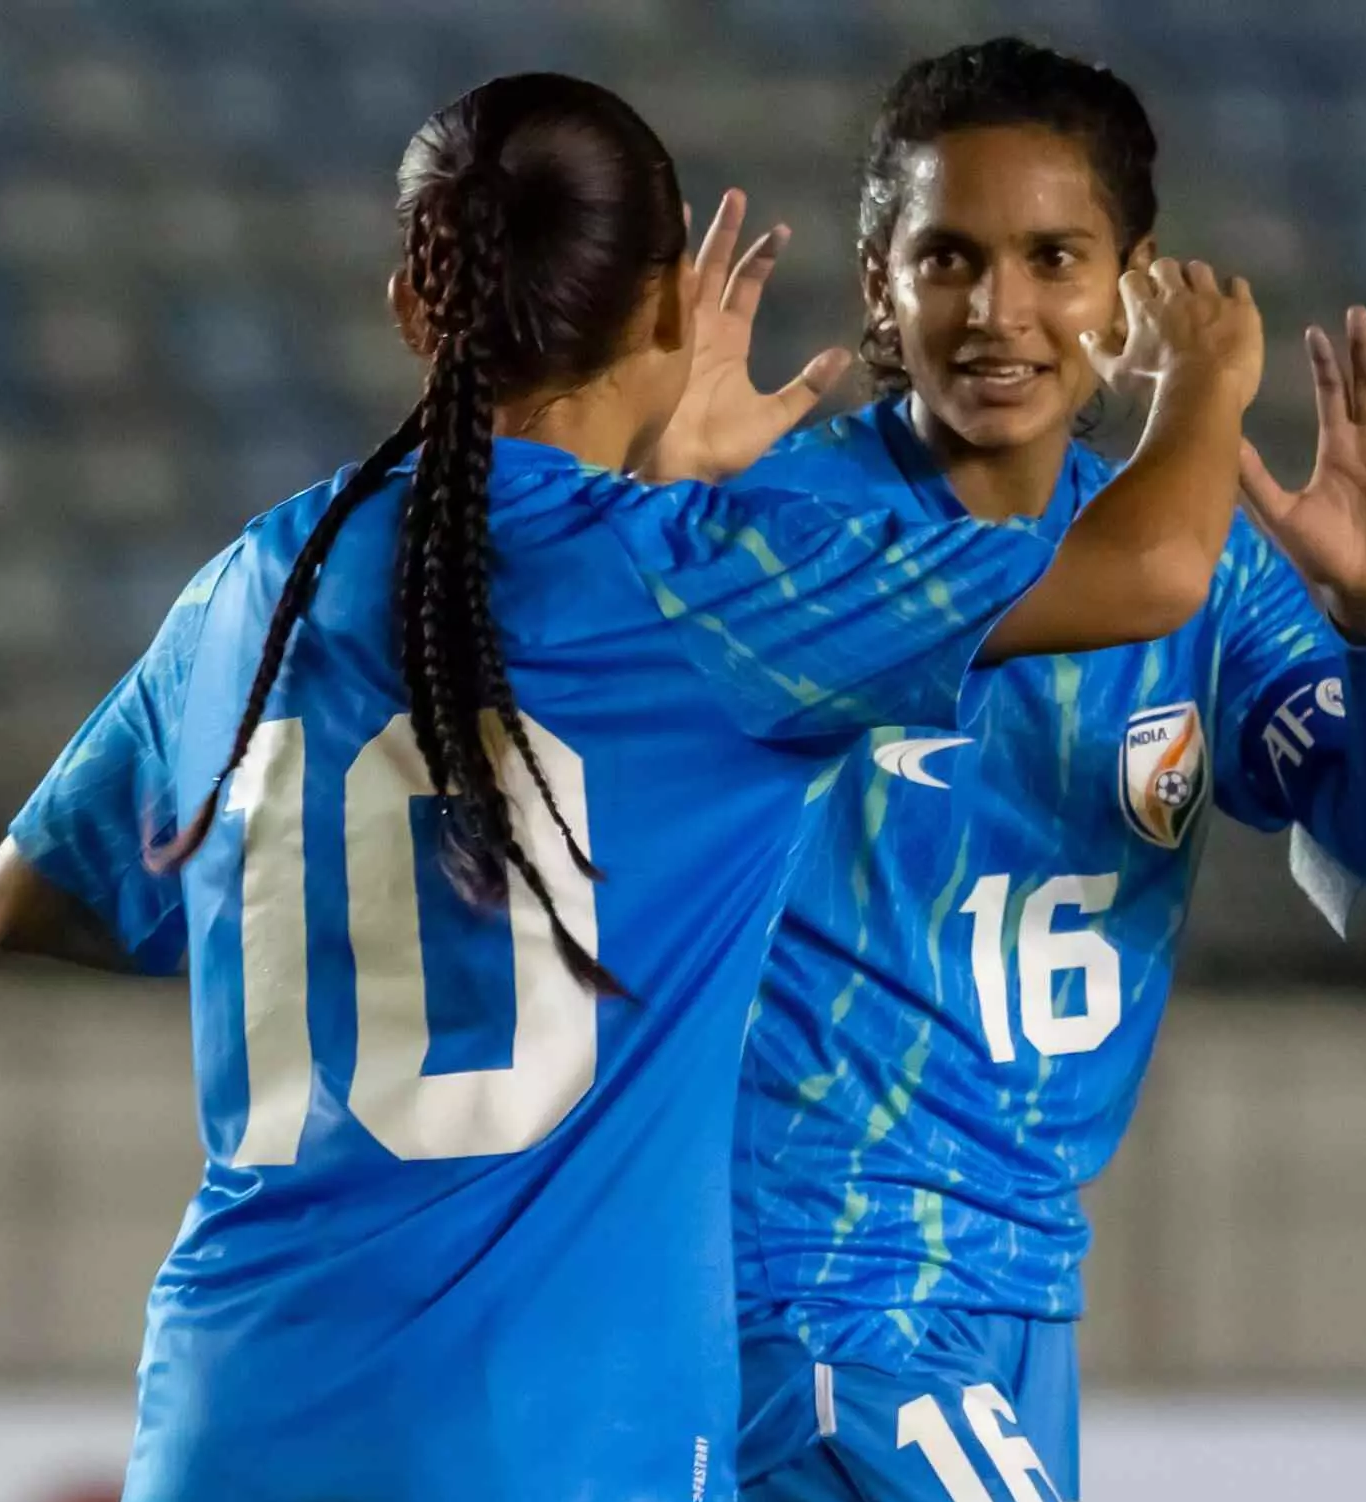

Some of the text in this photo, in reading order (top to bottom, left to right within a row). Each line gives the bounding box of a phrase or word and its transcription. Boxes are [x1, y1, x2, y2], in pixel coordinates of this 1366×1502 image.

[1128, 726, 1170, 750] INDIA
[224, 711, 600, 1168] 10
[958, 871, 1122, 1064] 16
